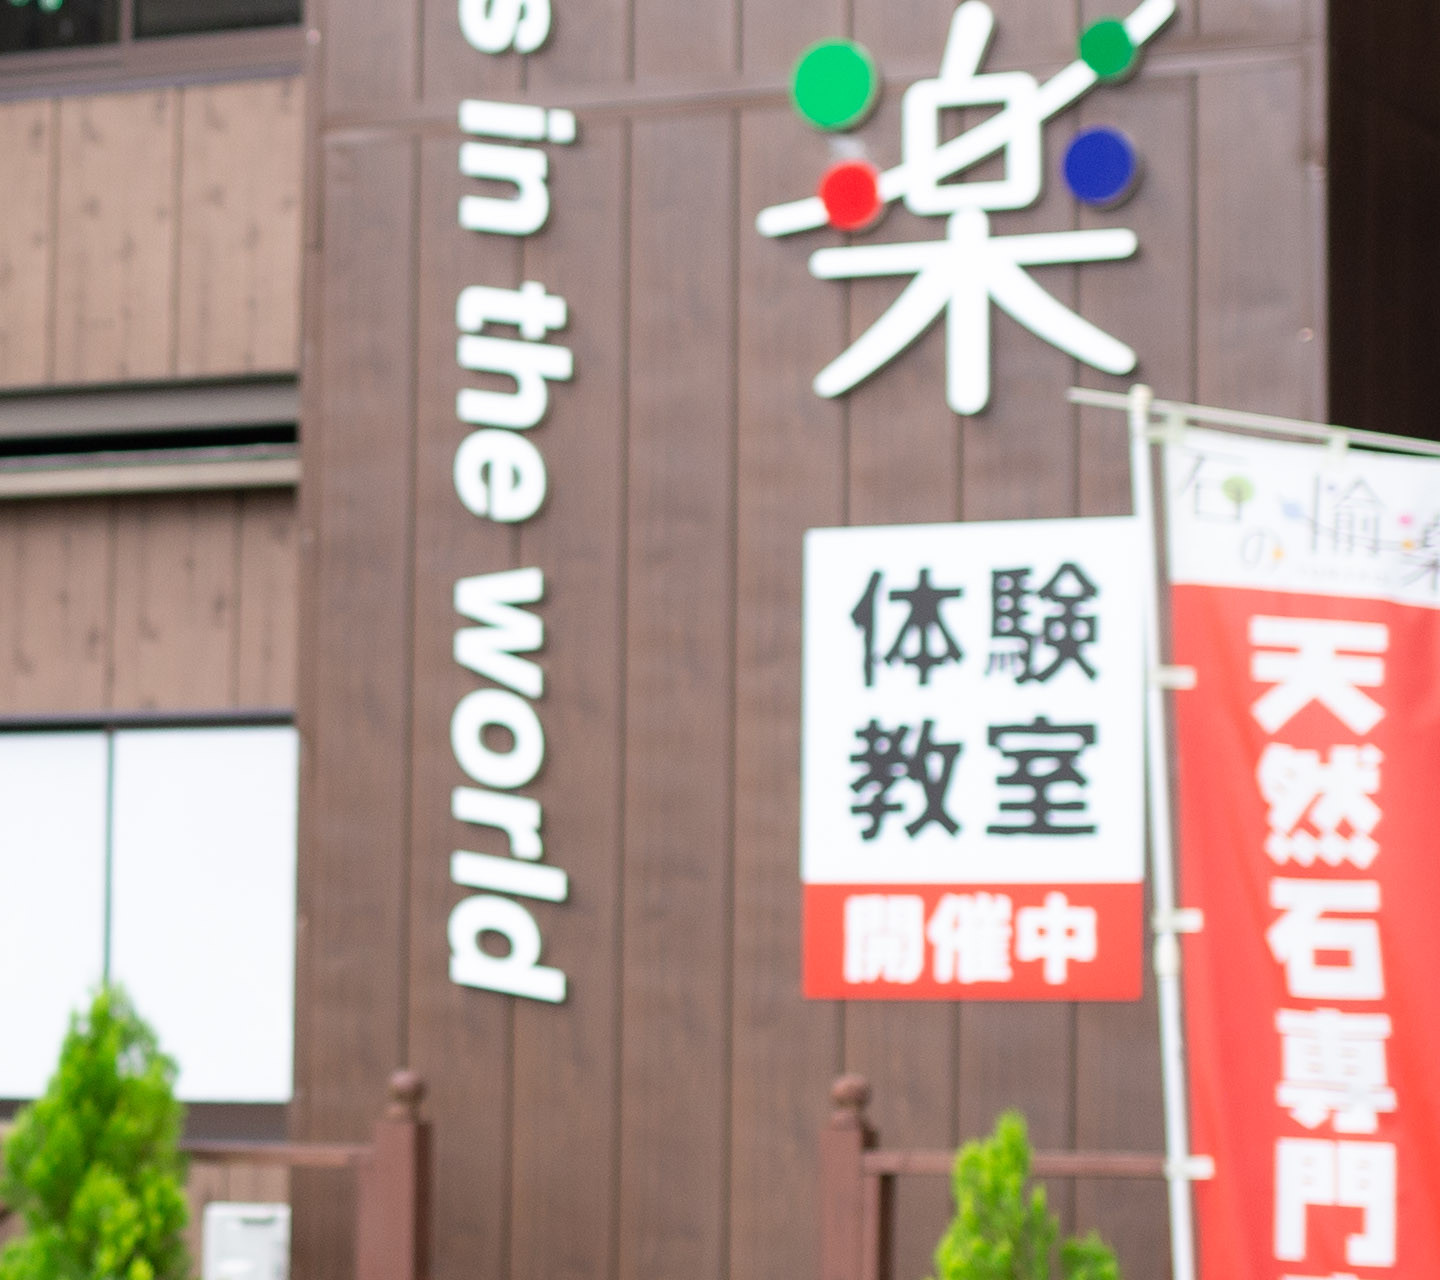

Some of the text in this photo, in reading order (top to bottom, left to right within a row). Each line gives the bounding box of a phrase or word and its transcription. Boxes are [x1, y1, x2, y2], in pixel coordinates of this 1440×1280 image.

[457, 98, 577, 236] in
[453, 280, 575, 525] the
[850, 560, 1101, 688] 体験
[446, 566, 570, 1004] world
[848, 714, 1098, 842] 教室
[842, 891, 1098, 986] 開催中
